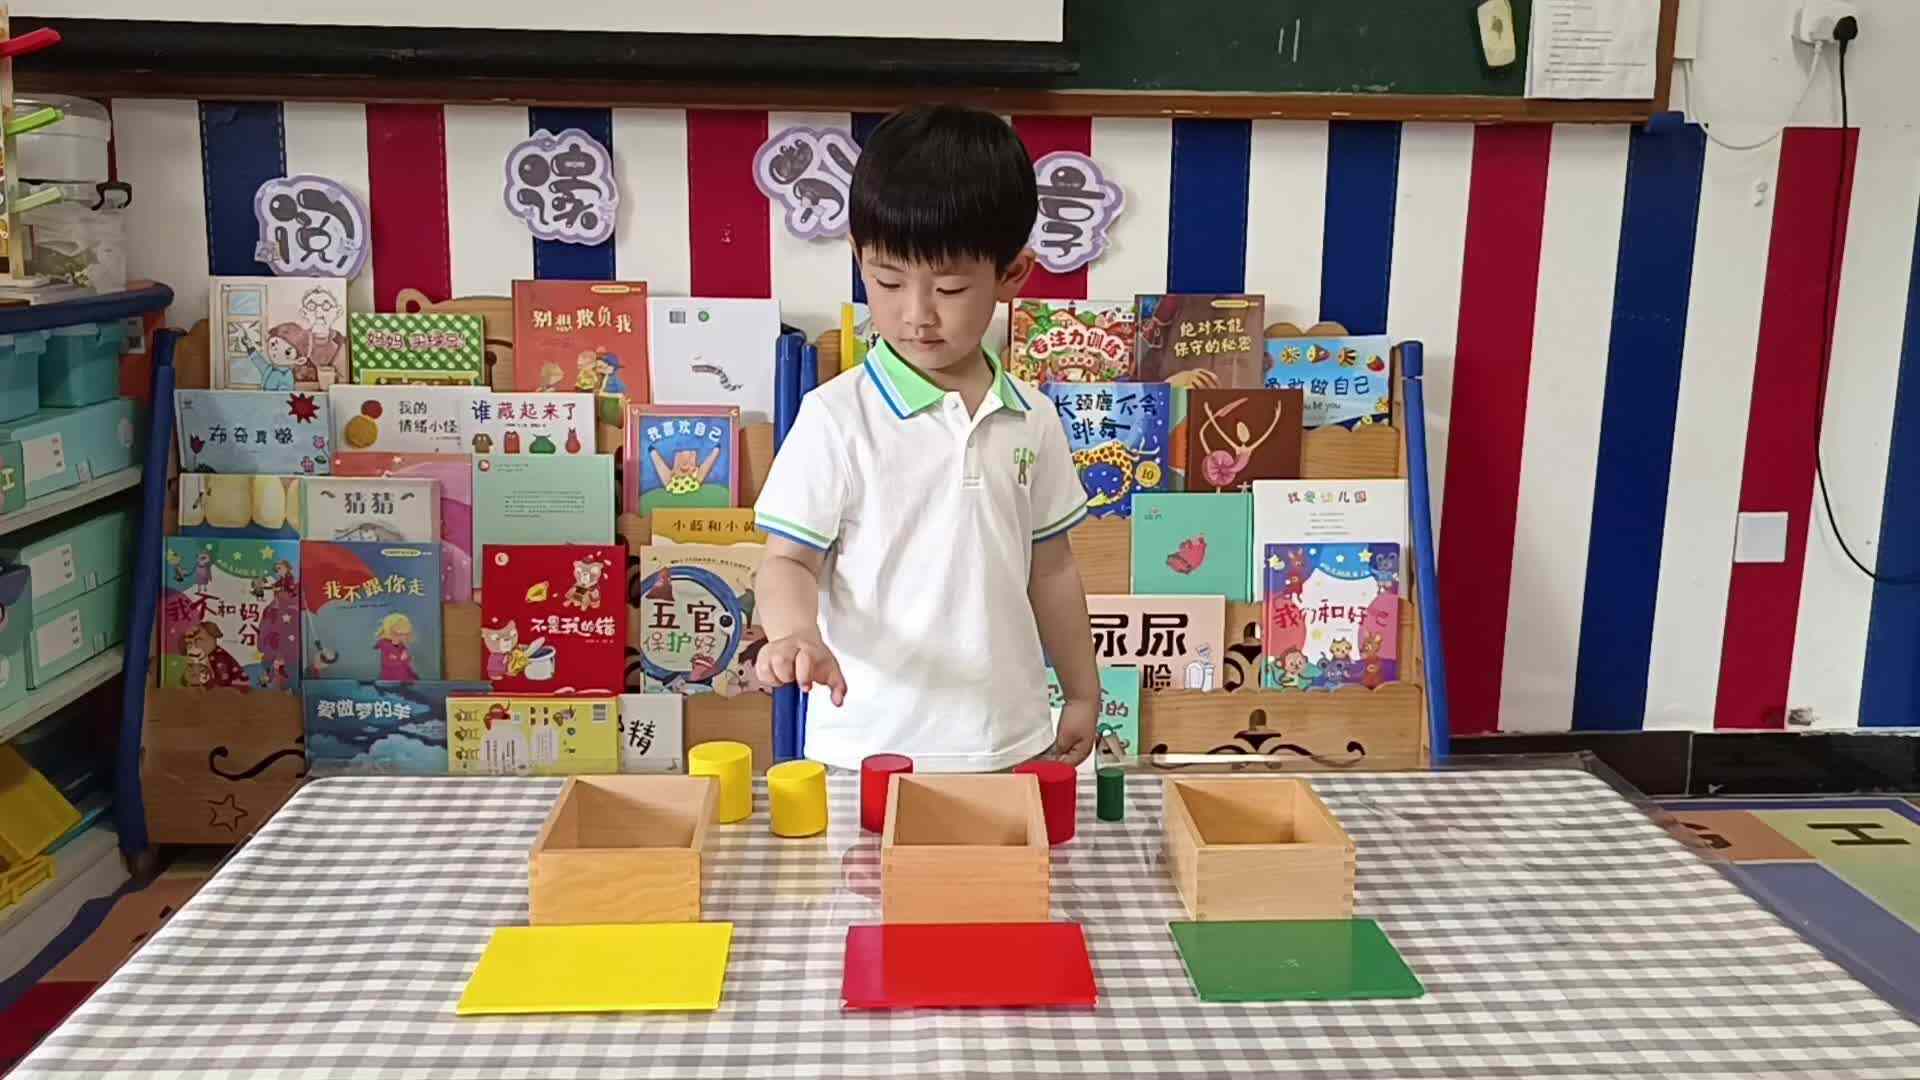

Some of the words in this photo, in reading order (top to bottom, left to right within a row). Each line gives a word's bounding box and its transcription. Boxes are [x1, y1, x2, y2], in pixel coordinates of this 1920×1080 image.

[532, 304, 634, 334] 别想欺负我
[1179, 317, 1245, 338] 绝对不能
[1173, 335, 1253, 358] 保守的秘密
[399, 400, 427, 415] 我的
[471, 399, 577, 425] 谁藏起来了
[1053, 389, 1158, 420] 长颈鹿不会
[646, 418, 723, 443] 我喜欢自己
[1071, 416, 1132, 445] 跳舞
[343, 491, 394, 515] 猜猜
[321, 573, 425, 604] 我不跟你走
[529, 614, 616, 637] 不是我的错
[648, 600, 716, 634] 五官
[643, 631, 717, 654] 保护好
